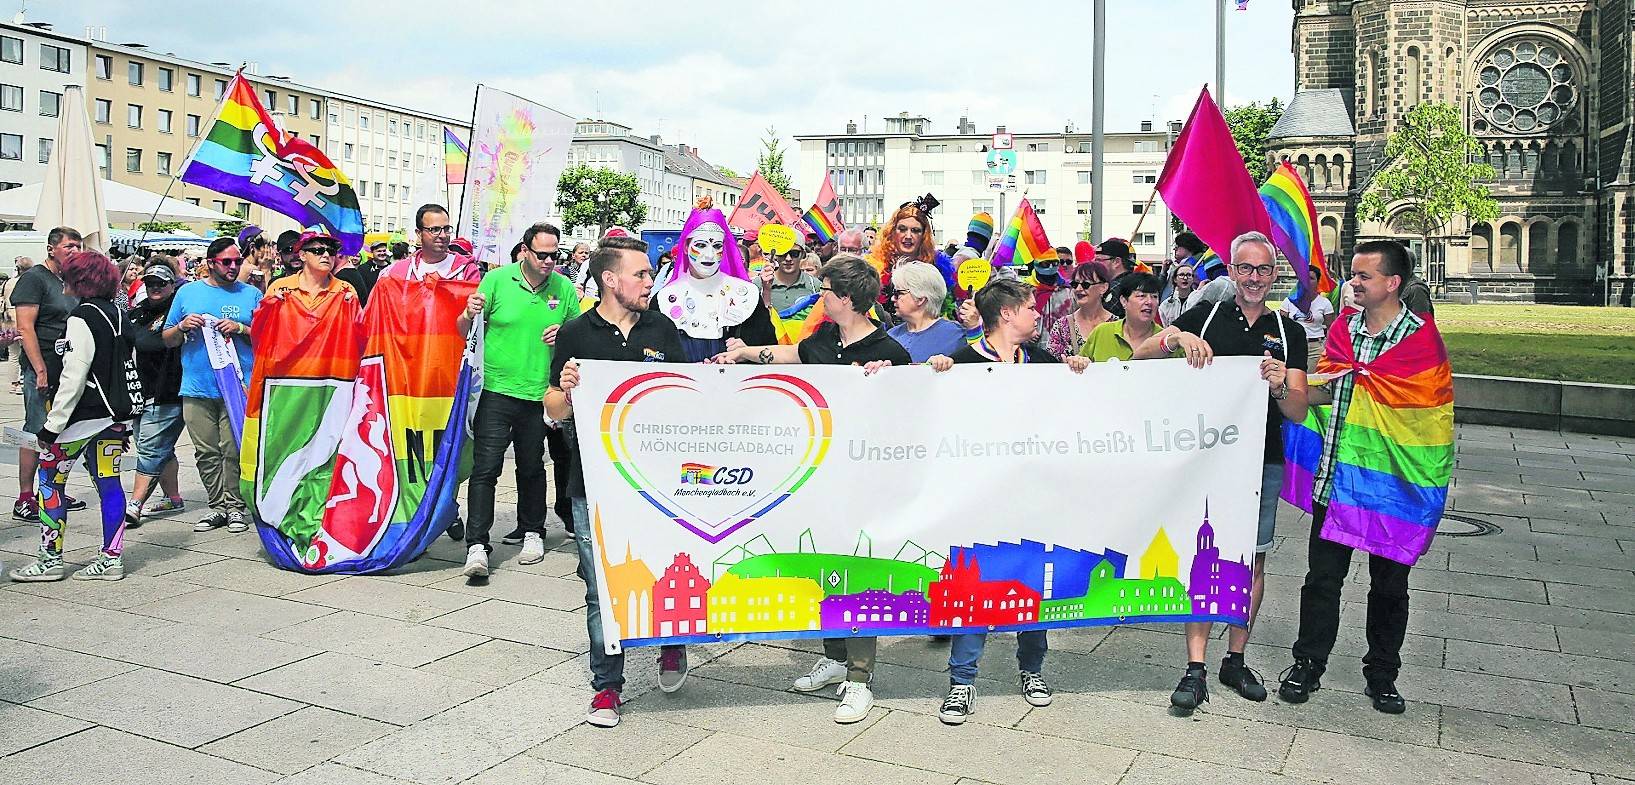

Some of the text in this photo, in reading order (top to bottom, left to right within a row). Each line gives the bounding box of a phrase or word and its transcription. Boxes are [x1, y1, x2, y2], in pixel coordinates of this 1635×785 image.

[221, 305, 240, 313] CSD
[633, 423, 801, 438] CHRISTOPHER STREET DAY
[847, 413, 1240, 462] Unsere Alternative heißt Liebe
[639, 438, 795, 456] MÖNCHENGLADBACH
[712, 466, 754, 485] CSD
[742, 489, 756, 498] e.V.
